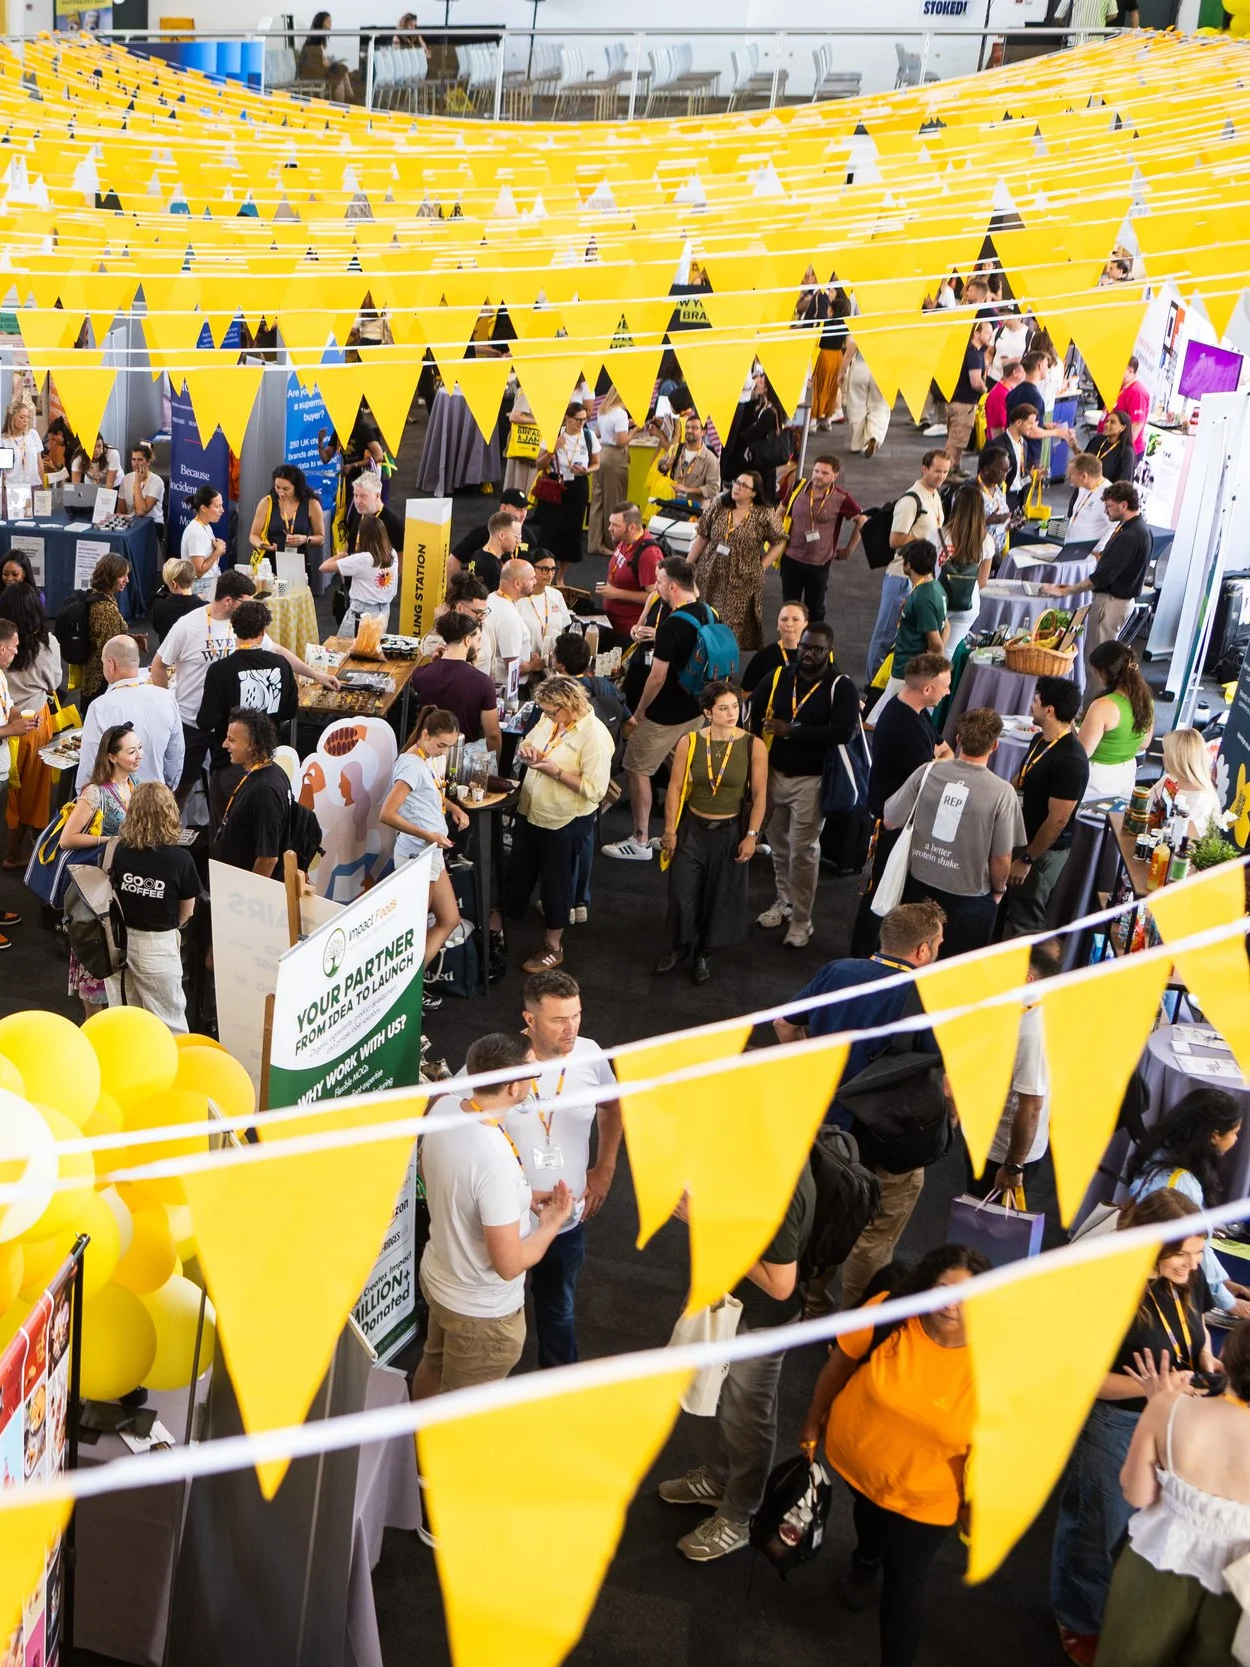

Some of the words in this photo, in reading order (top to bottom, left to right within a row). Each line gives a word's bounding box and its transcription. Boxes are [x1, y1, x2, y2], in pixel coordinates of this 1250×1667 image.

[923, 0, 968, 16] STOKED!
[287, 388, 299, 398] Are
[303, 410, 325, 422] buyer?
[301, 439, 310, 447] UK
[180, 463, 211, 482] Because
[415, 543, 426, 602] STATION
[411, 603, 422, 640] LING
[205, 638, 237, 649] EVE
[943, 795, 963, 808] REP
[911, 848, 936, 862] protein
[937, 856, 960, 869] shake.
[930, 842, 952, 858] better
[120, 881, 165, 899] KOFFEE
[122, 872, 166, 891] GOOD
[349, 913, 374, 942] Impact
[374, 898, 398, 922] Foods
[297, 983, 340, 1034] YOUR
[344, 928, 415, 998] PARTNER
[295, 1020, 326, 1056] FROM
[328, 998, 353, 1030] IDEA
[356, 985, 370, 1006] TO
[372, 952, 414, 995] LAUNCH
[297, 1078, 325, 1109] WHY
[325, 1051, 358, 1089] WORK
[359, 1029, 386, 1061] WITH
[387, 1014, 407, 1039] US?
[334, 1077, 353, 1098] Flexible
[353, 1064, 369, 1083] MOQs
[363, 1269, 387, 1298] Creates
[389, 1251, 412, 1275] Impact
[361, 1282, 410, 1336] Donated
